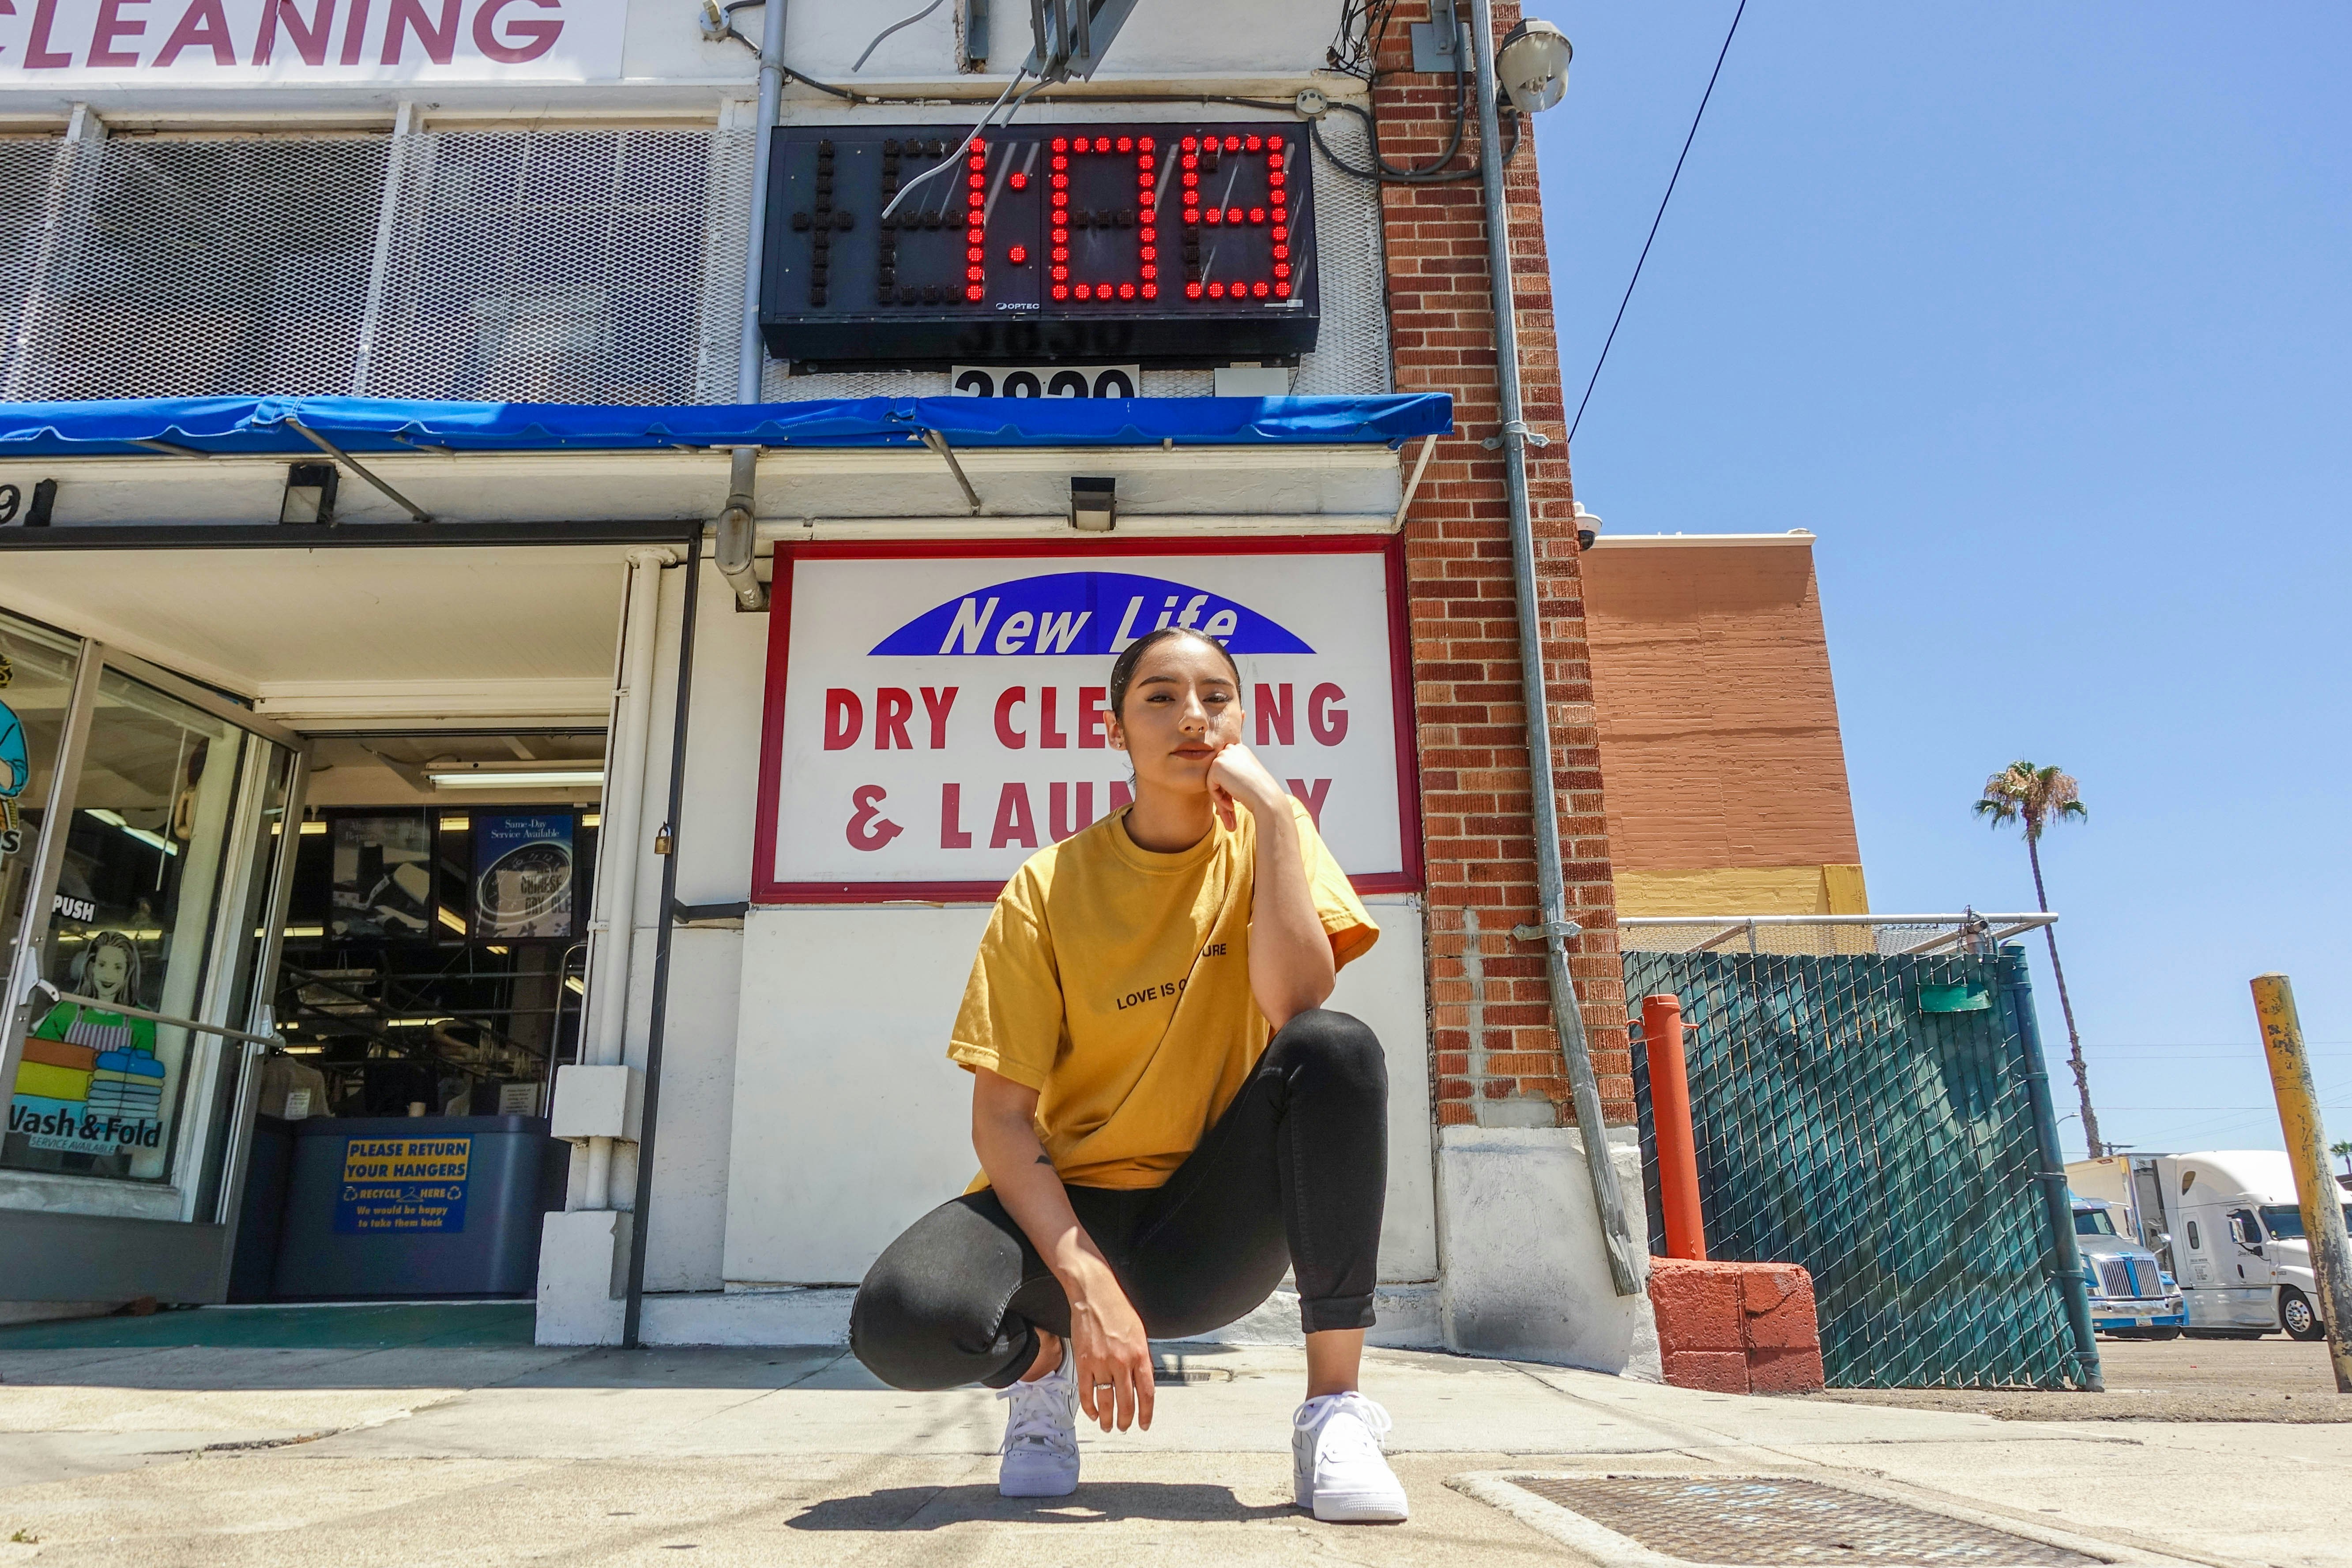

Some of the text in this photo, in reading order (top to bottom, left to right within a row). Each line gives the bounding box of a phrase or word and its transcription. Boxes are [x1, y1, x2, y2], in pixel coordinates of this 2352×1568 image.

[0, 0, 564, 68] LEANING
[968, 135, 1293, 301] 1:09
[940, 595, 1237, 654] New Life
[824, 683, 1348, 750] DRY CLENG
[505, 819, 546, 828] Same-Day
[846, 784, 904, 851] &
[491, 828, 560, 839] Service Available
[52, 895, 95, 922] PUSH
[1117, 987, 1157, 1010] LOVE
[1160, 982, 1175, 997] IS
[79, 1114, 100, 1140] &
[104, 1118, 162, 1148] Fold
[31, 1136, 68, 1149] SERVICE
[350, 1143, 467, 1157] PLEASE RETURN
[346, 1163, 466, 1177] YOUR HANGERS
[360, 1188, 446, 1199] RECYCLE HERE
[357, 1205, 448, 1216] We would be happy
[358, 1218, 443, 1228] to take them back
